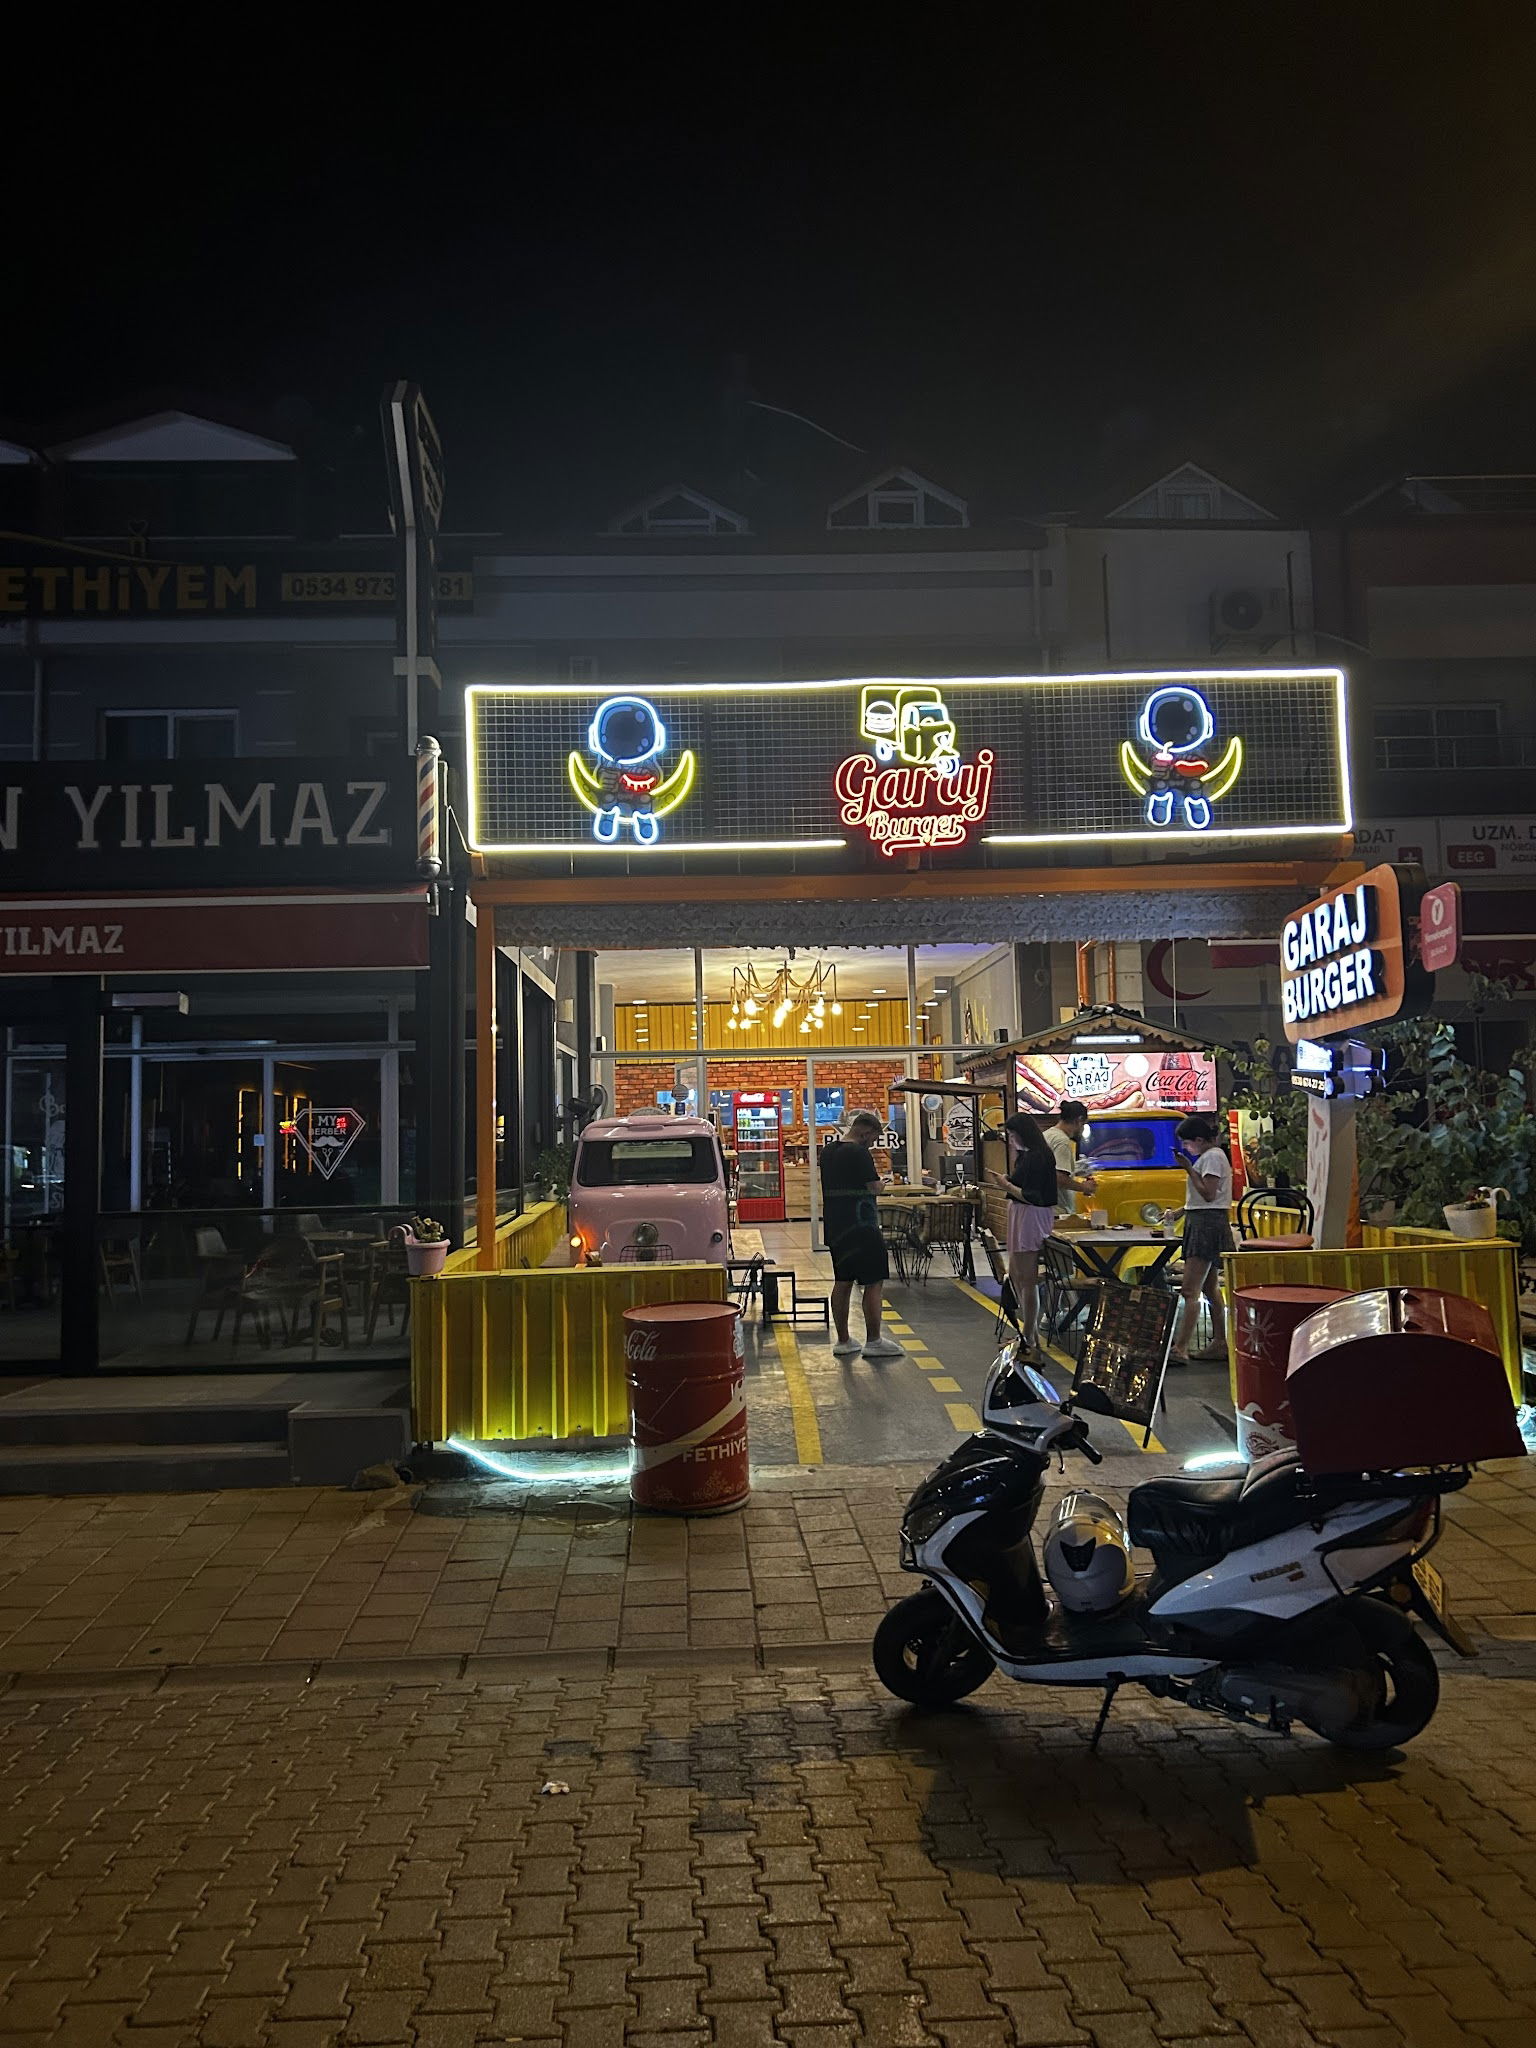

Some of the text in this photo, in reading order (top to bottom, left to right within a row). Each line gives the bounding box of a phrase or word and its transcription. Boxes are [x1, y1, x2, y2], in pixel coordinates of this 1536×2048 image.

[291, 577, 347, 597] 0534
[835, 748, 994, 825] Garaj
[64, 780, 391, 849] YILMAZ
[867, 810, 966, 848] Burger
[1472, 826, 1522, 840] UZM.
[1457, 852, 1486, 863] EEG
[1283, 885, 1366, 972] GARAJ
[0, 924, 125, 957] ILMAZ
[1283, 948, 1375, 1023] BURGER
[1067, 1070, 1109, 1087] GARAJ
[1072, 1083, 1108, 1094] BURGER
[1146, 1070, 1210, 1091] Coca-Cola
[317, 1115, 337, 1126] MY
